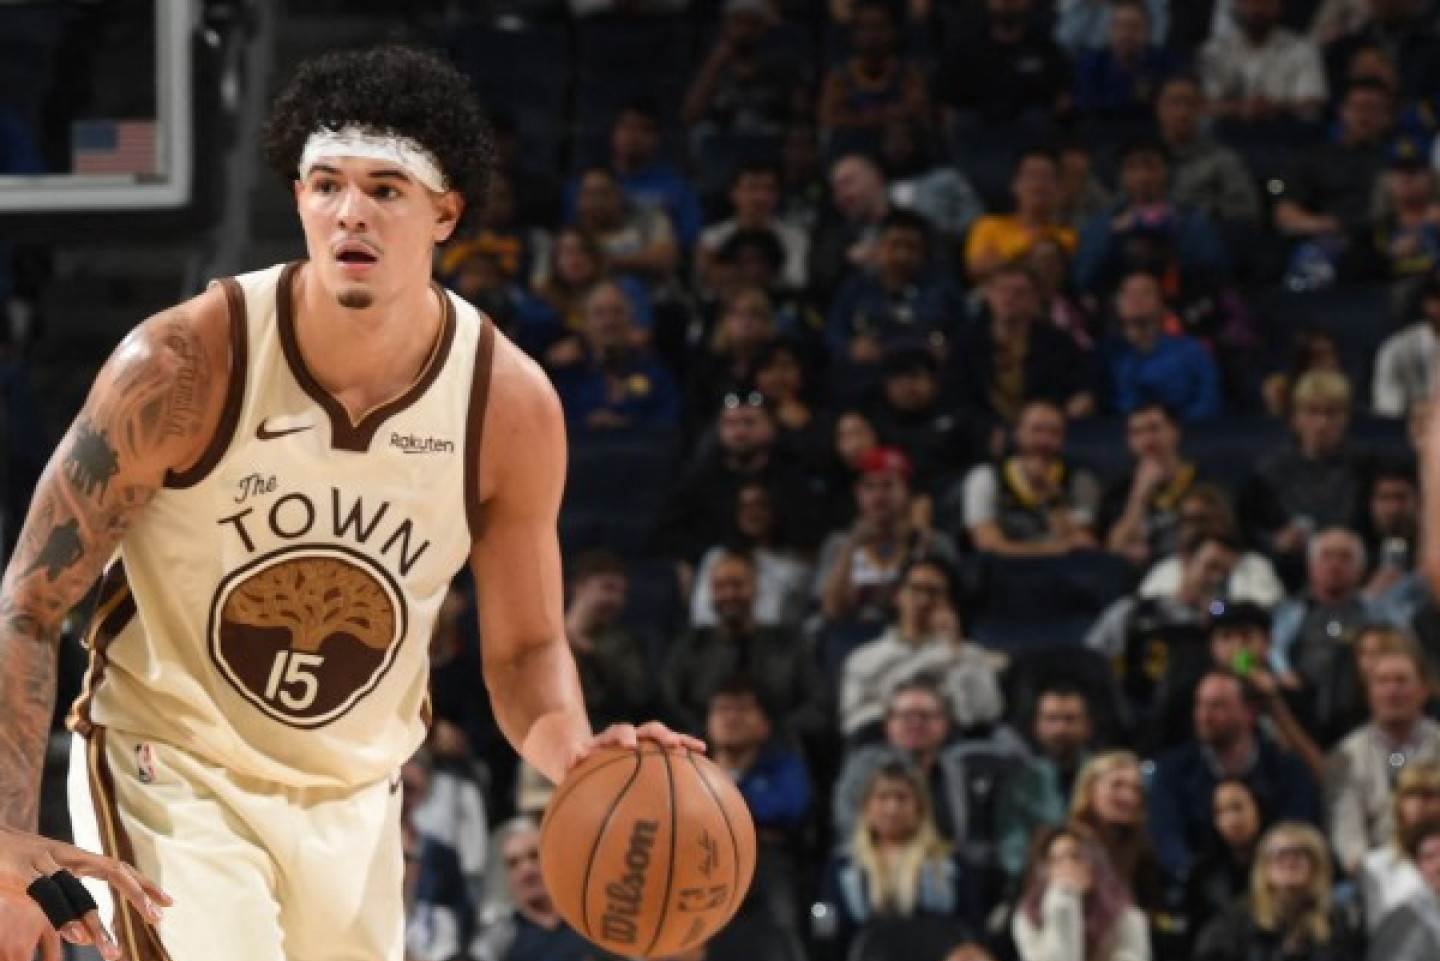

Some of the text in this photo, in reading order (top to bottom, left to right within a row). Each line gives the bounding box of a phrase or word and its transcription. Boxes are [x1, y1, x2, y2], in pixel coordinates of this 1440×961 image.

[390, 432, 455, 454] Rakuten
[234, 472, 277, 502] The
[217, 487, 430, 576] TOWN
[265, 650, 324, 710] 15
[602, 821, 658, 943] Wilson
